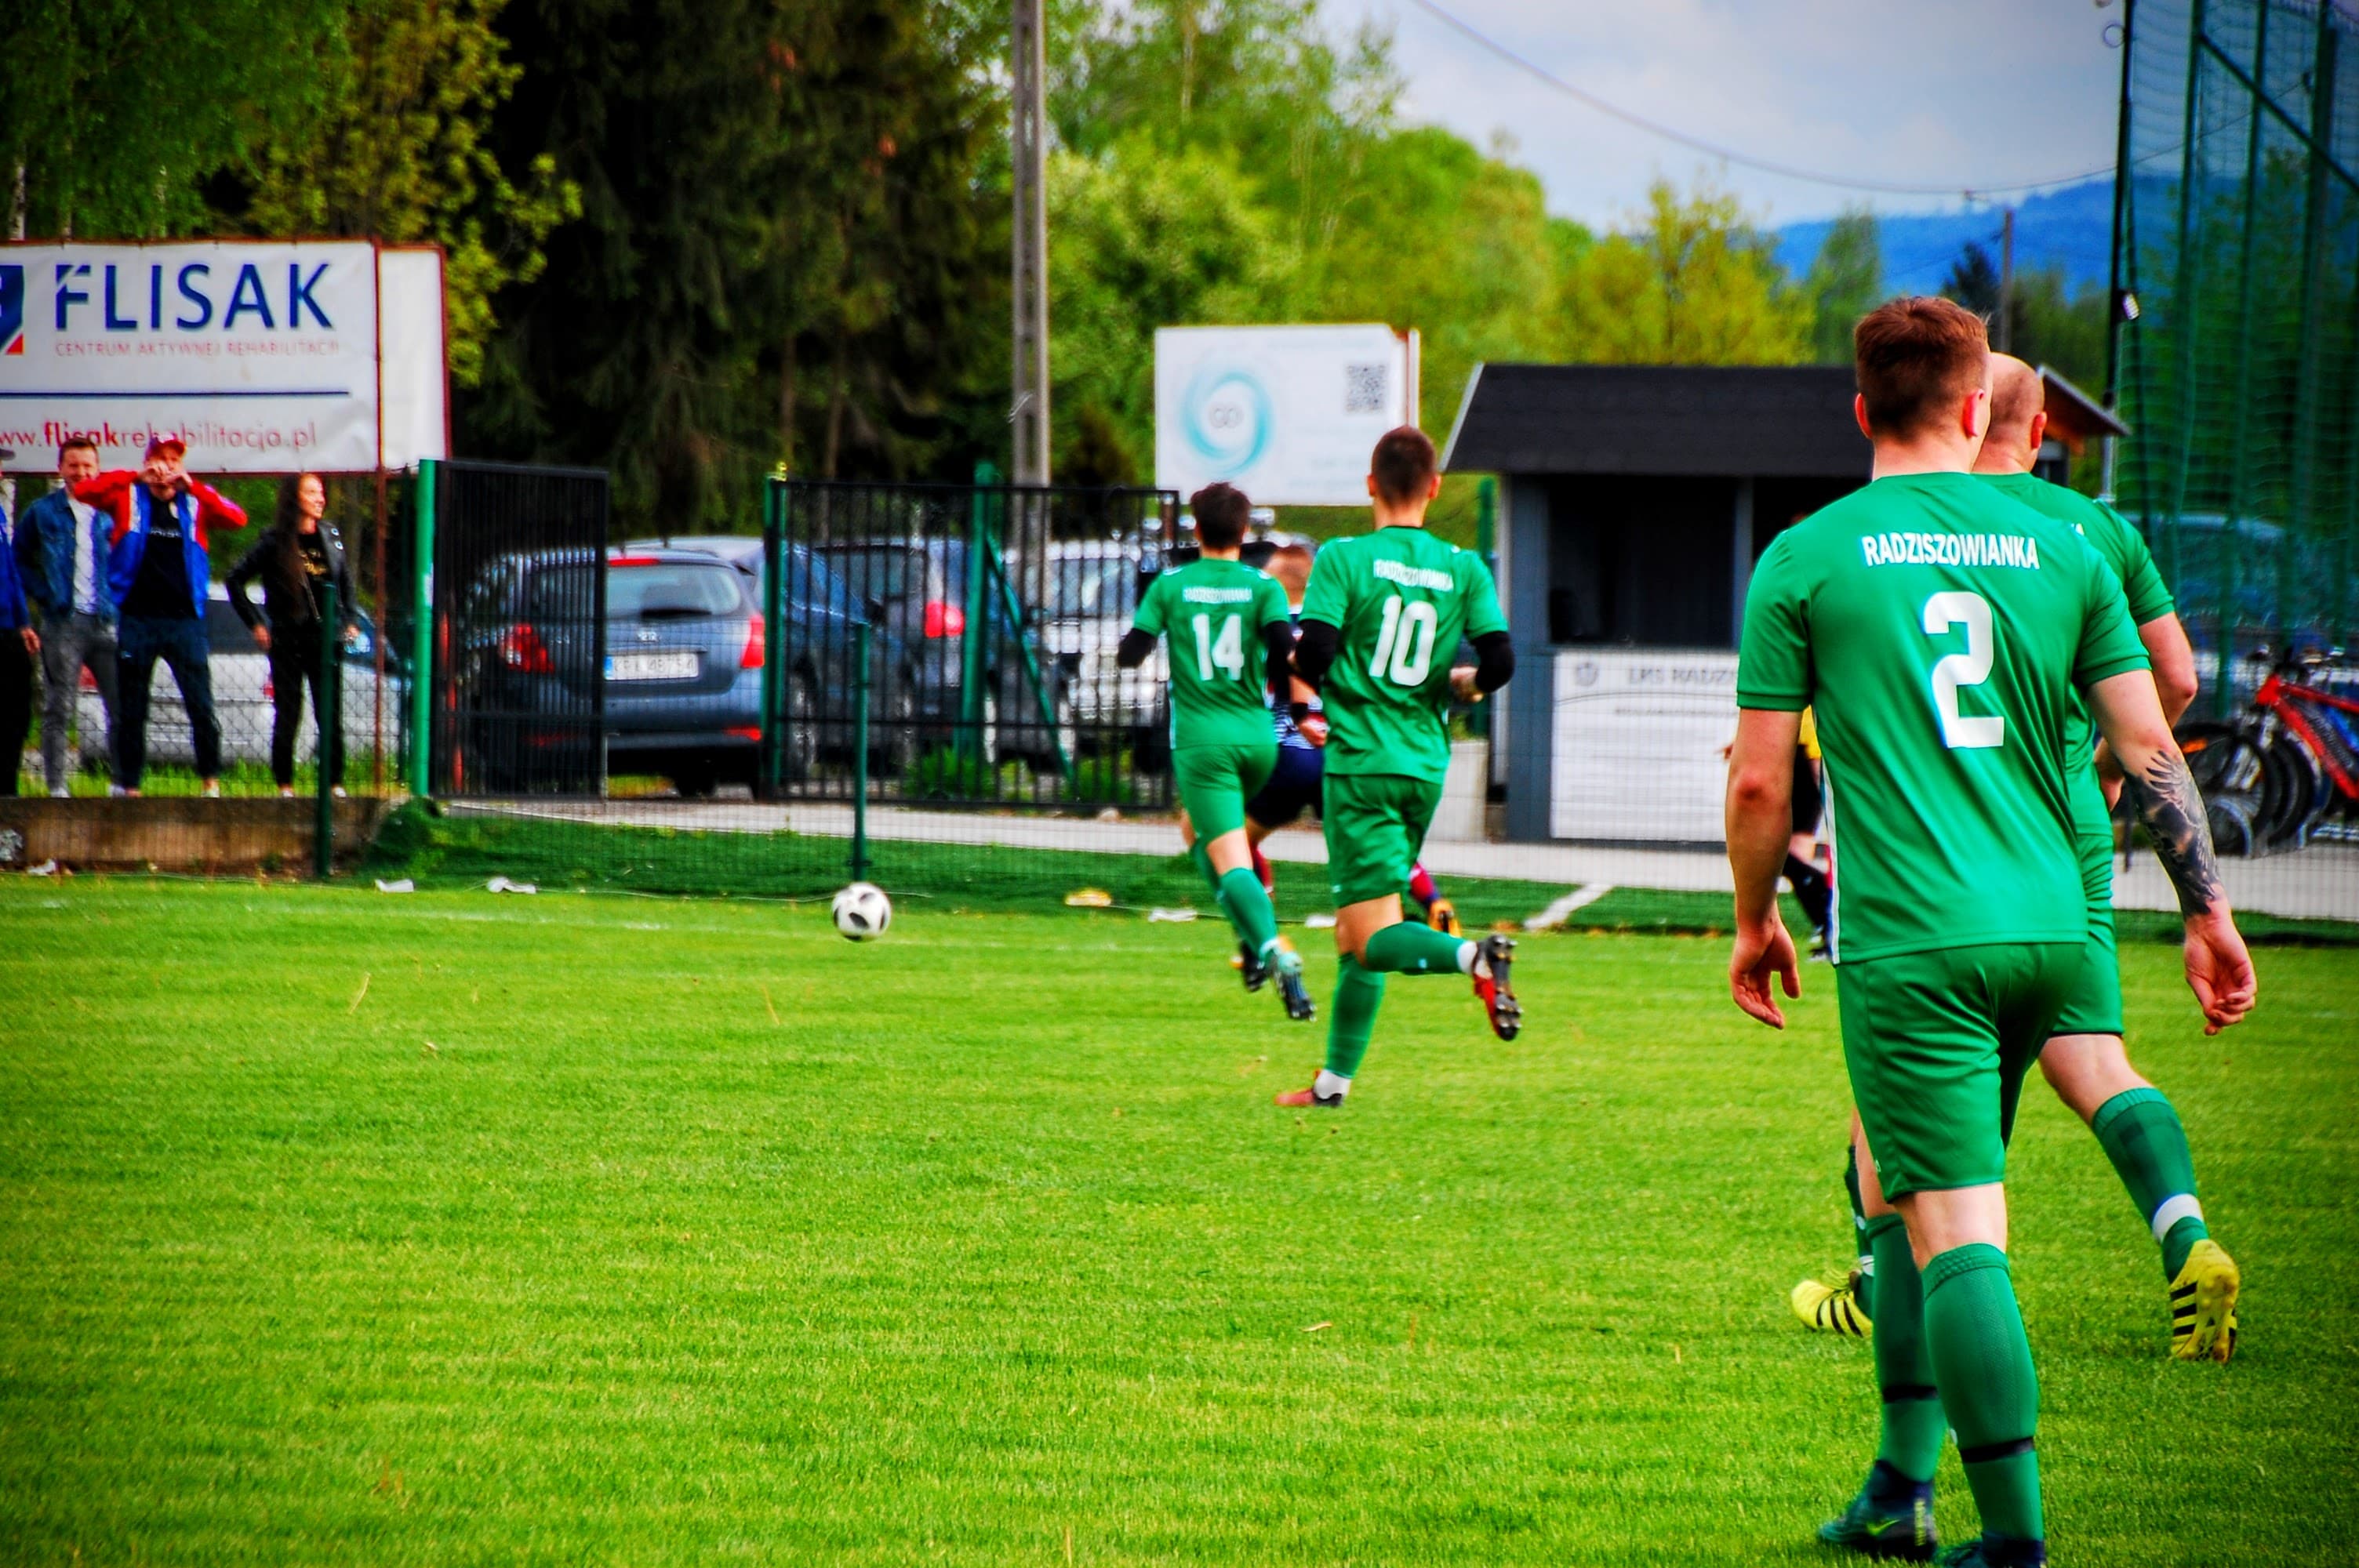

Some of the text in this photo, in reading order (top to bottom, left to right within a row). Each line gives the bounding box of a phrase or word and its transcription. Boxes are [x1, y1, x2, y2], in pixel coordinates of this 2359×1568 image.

[55, 263, 333, 331] FLISAK
[56, 340, 130, 357] CENTRUM
[137, 340, 220, 357] AKTYWNEJ
[1862, 532, 2040, 569] RADZISZOWIANKA
[1192, 614, 1245, 681] 14
[1369, 594, 1438, 686] 10
[1923, 591, 2005, 749] 2
